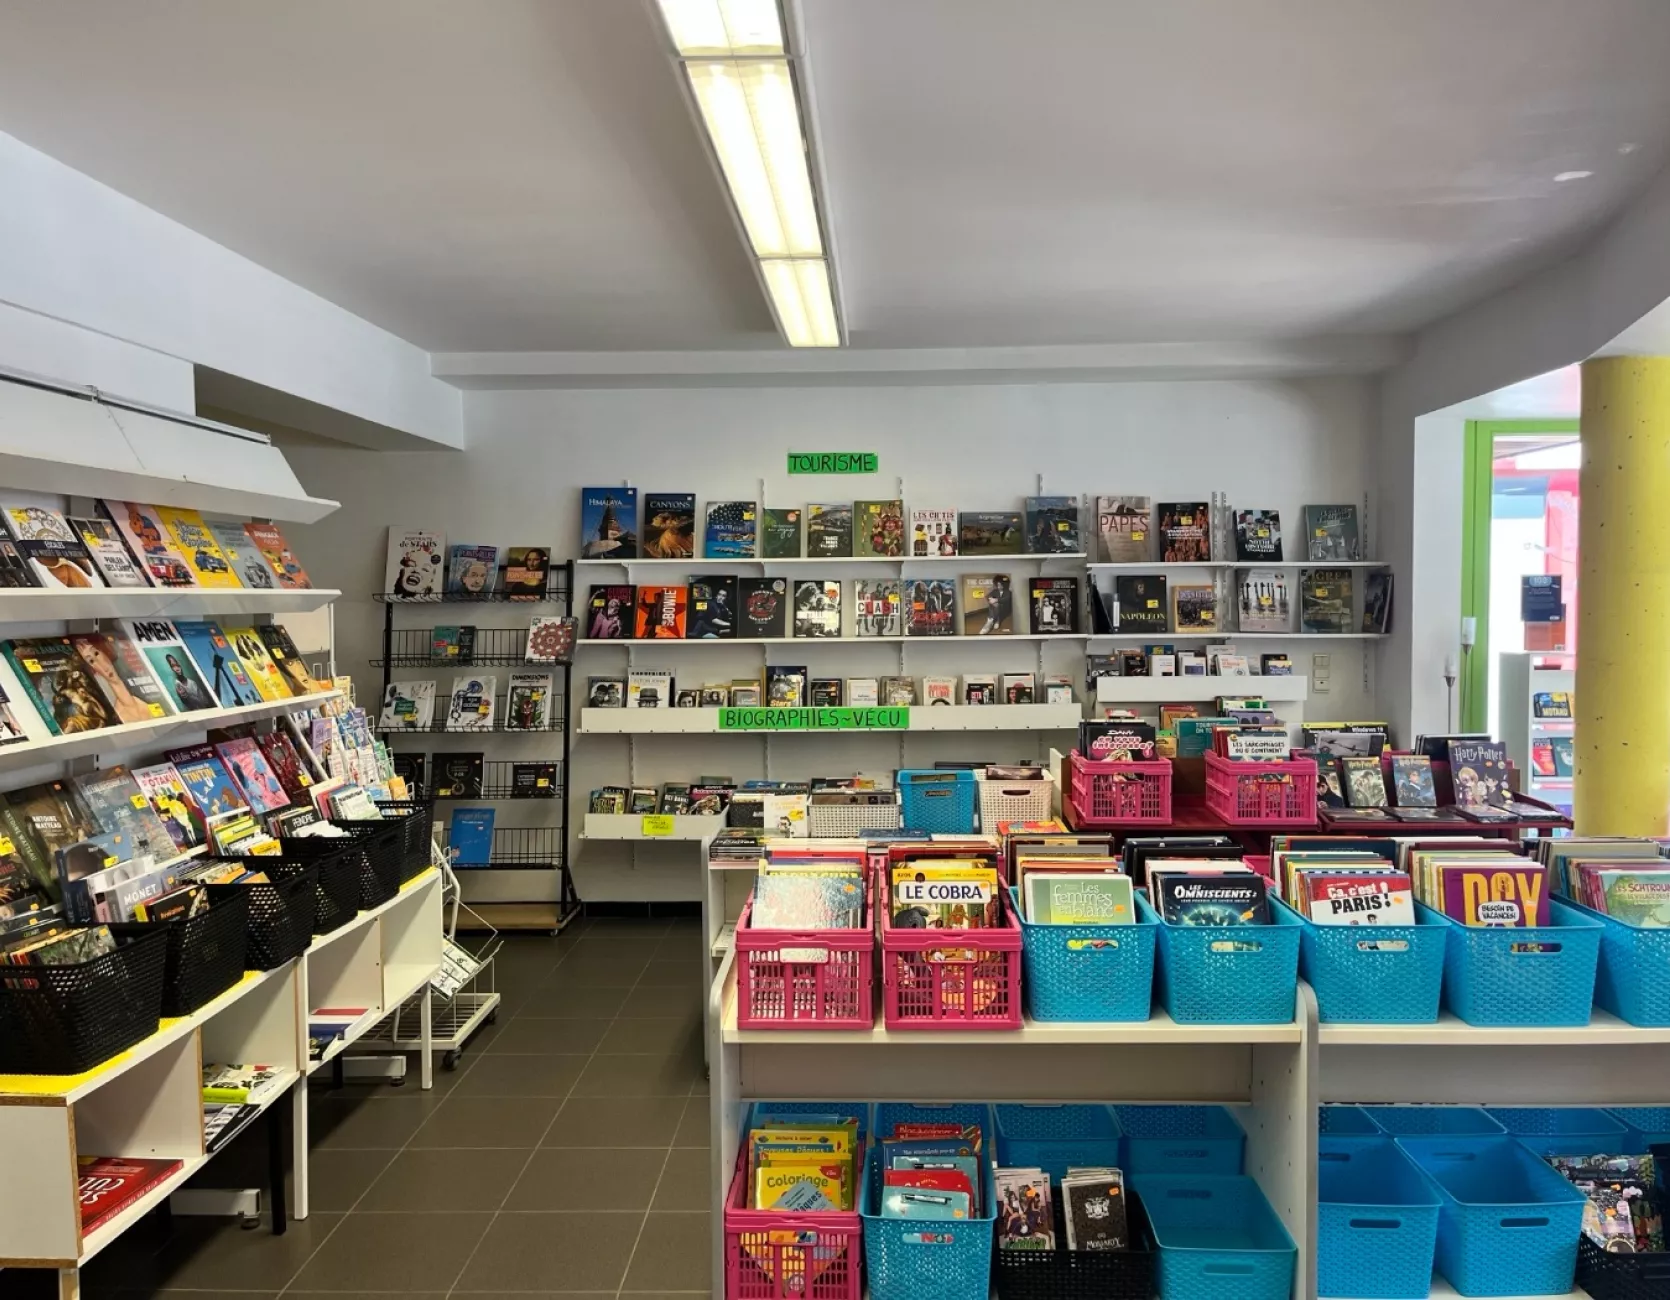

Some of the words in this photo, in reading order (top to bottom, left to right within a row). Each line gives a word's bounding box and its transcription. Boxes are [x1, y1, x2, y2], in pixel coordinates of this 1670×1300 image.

[789, 452, 875, 472] TOURISME
[650, 501, 691, 509] CANYONS
[1100, 515, 1149, 532] PAPES
[662, 589, 677, 620] BOWIE
[858, 601, 900, 614] CLASH
[133, 621, 177, 642] AMEN
[1455, 748, 1477, 762] Harry
[1477, 747, 1504, 761] Potter
[123, 883, 157, 905] MONET
[906, 885, 923, 899] LE
[928, 885, 983, 899] COBRA
[1081, 881, 1099, 893] Les
[1175, 885, 1253, 898] OMNISCIENTS
[1052, 884, 1113, 906] femmes
[767, 1174, 829, 1188] Coloriage
